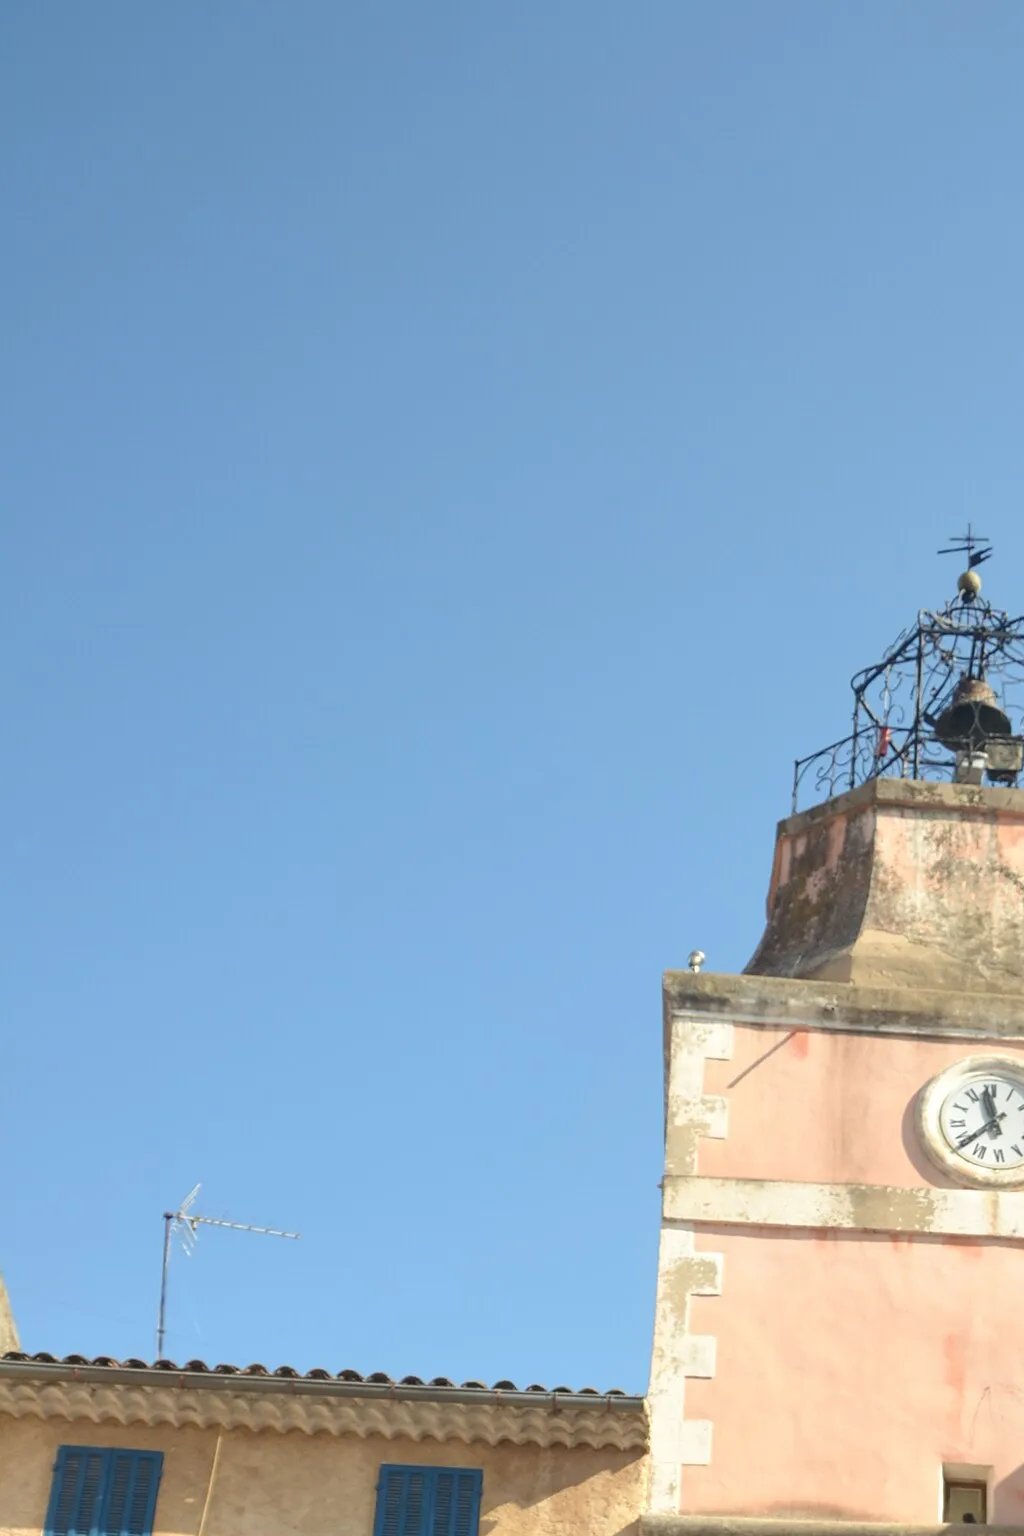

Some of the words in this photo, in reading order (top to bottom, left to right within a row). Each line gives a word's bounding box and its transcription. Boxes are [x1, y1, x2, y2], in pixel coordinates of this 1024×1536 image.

[965, 1088, 979, 1103] XI
[1006, 1088, 1014, 1102] I
[953, 1102, 968, 1113] X
[950, 1119, 965, 1127] IX
[973, 1143, 987, 1159] VII
[993, 1148, 1005, 1163] VI
[1011, 1143, 1023, 1157] V
